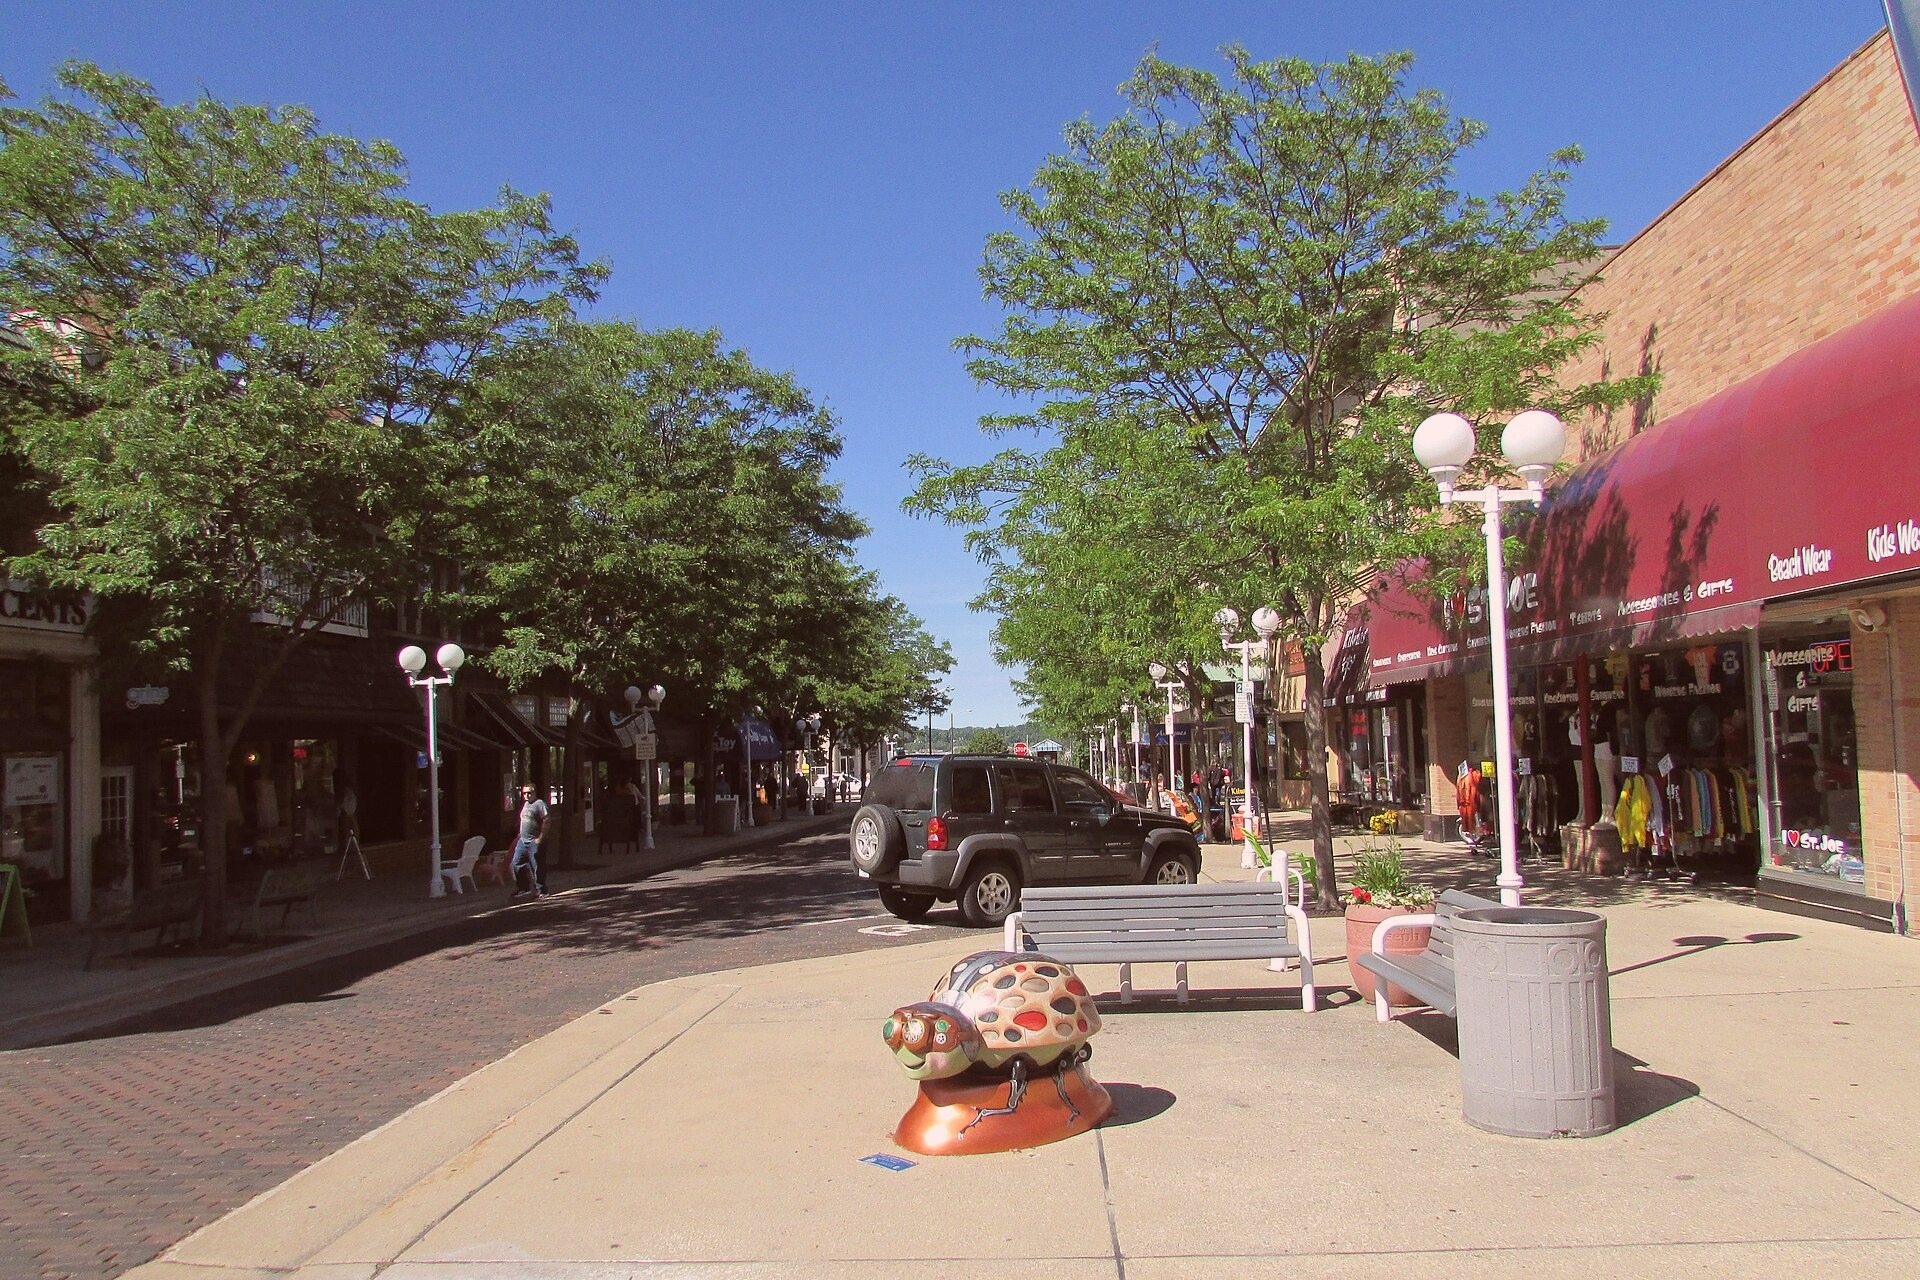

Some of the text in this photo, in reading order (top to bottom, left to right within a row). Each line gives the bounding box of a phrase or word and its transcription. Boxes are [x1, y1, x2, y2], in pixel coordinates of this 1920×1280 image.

[1867, 519, 1920, 562] Kids We
[1767, 544, 1832, 582] Beach Wear
[1697, 578, 1734, 598] GIFTS
[1796, 670, 1806, 689] &
[1787, 695, 1819, 712] GIFTS
[719, 737, 736, 749] Toy
